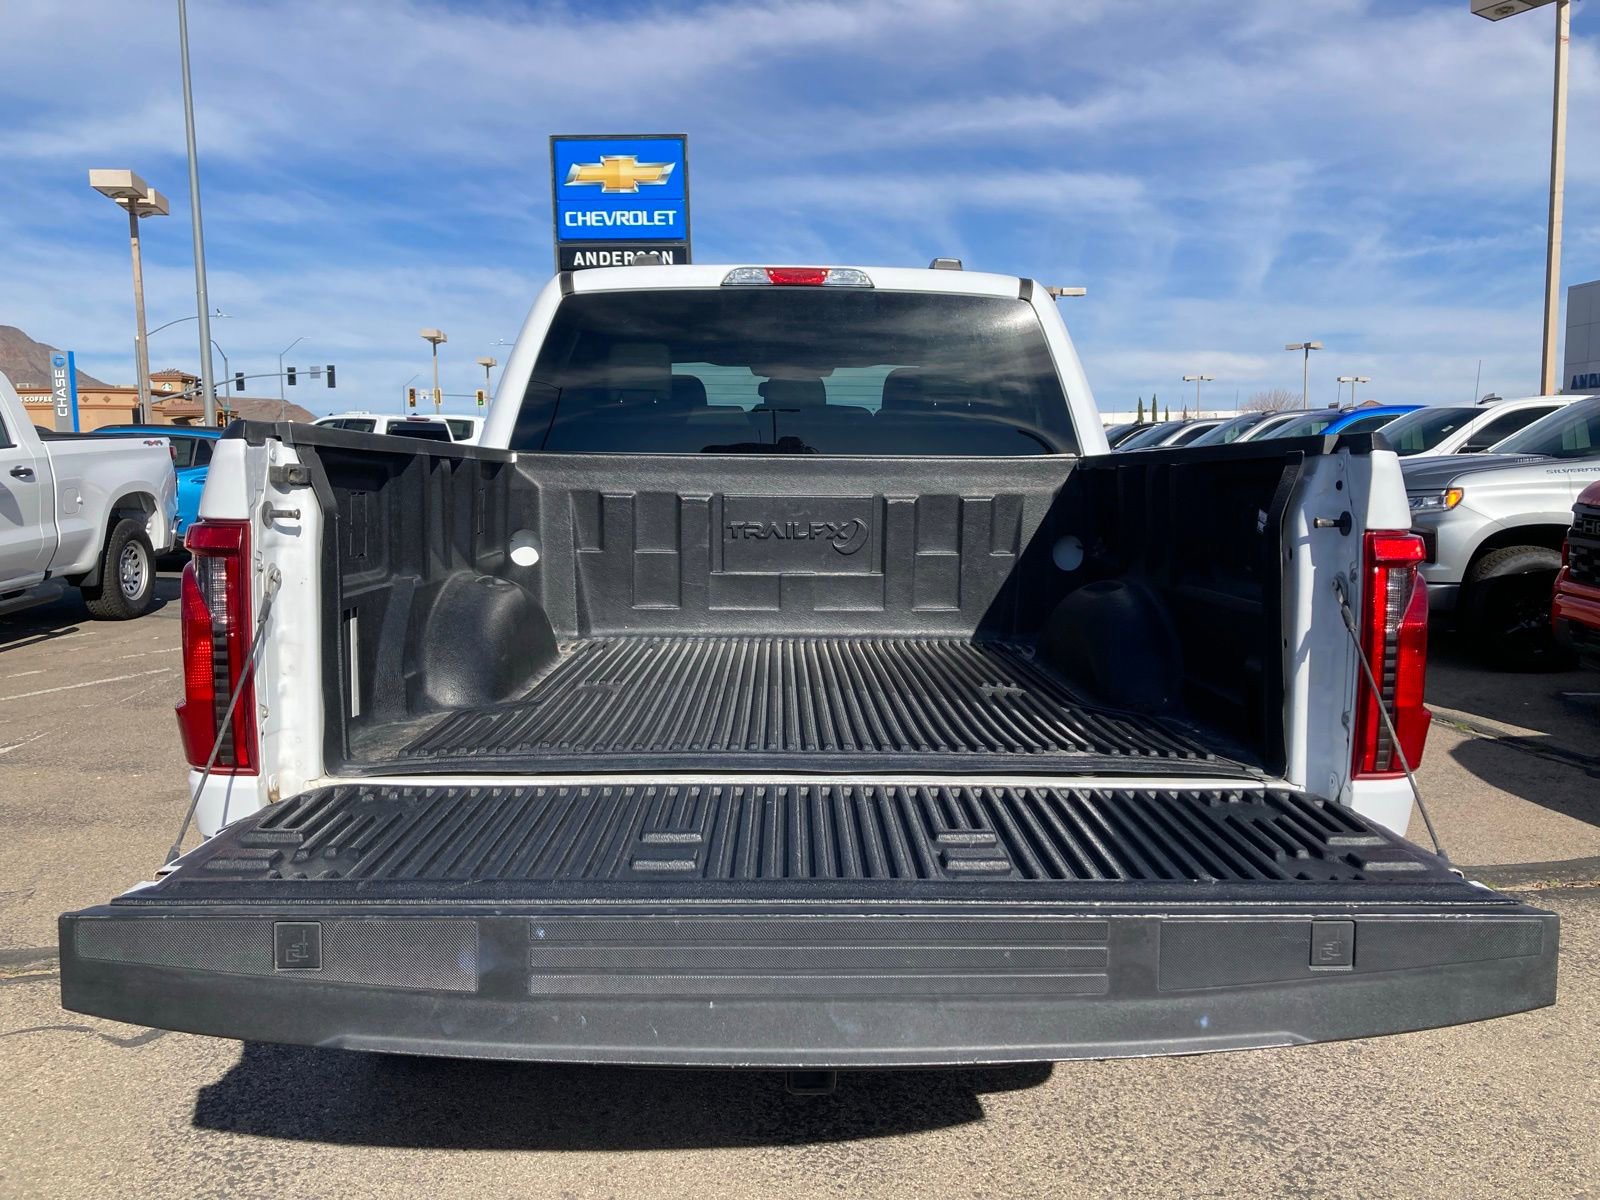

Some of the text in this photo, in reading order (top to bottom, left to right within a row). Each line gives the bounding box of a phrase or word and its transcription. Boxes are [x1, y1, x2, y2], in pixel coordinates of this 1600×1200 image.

[565, 210, 677, 226] CHEVROLET
[573, 250, 674, 266] ANDERN
[1571, 372, 1600, 390] AND
[54, 369, 68, 417] CHASE
[726, 520, 849, 541] TRAILFX
